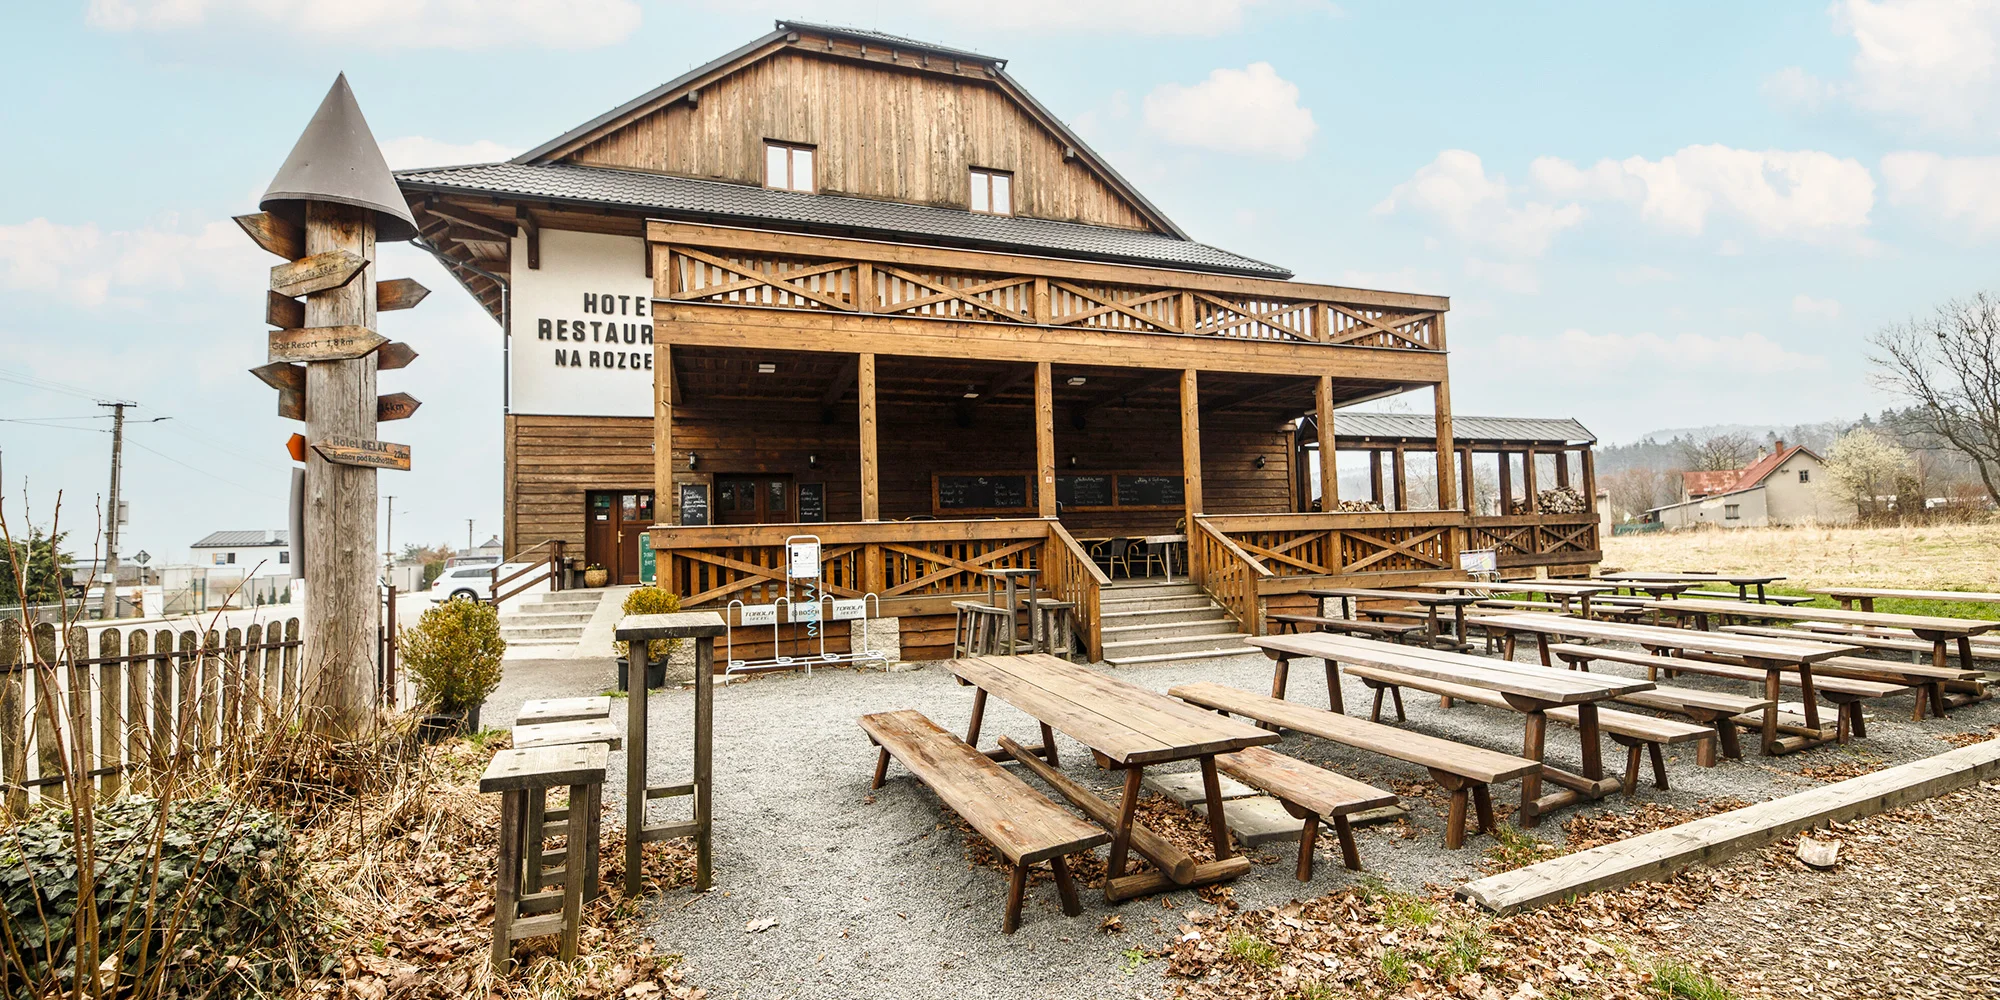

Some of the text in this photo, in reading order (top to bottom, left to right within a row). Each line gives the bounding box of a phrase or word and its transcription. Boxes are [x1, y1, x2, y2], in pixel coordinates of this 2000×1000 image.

[583, 292, 653, 317] HOTE
[538, 318, 653, 345] RESTAUR
[272, 341, 289, 350] Golf
[291, 340, 318, 349] Resort
[555, 348, 653, 371] NA ROZCE
[333, 436, 388, 453] Hotel RELAX
[356, 454, 367, 463] pod
